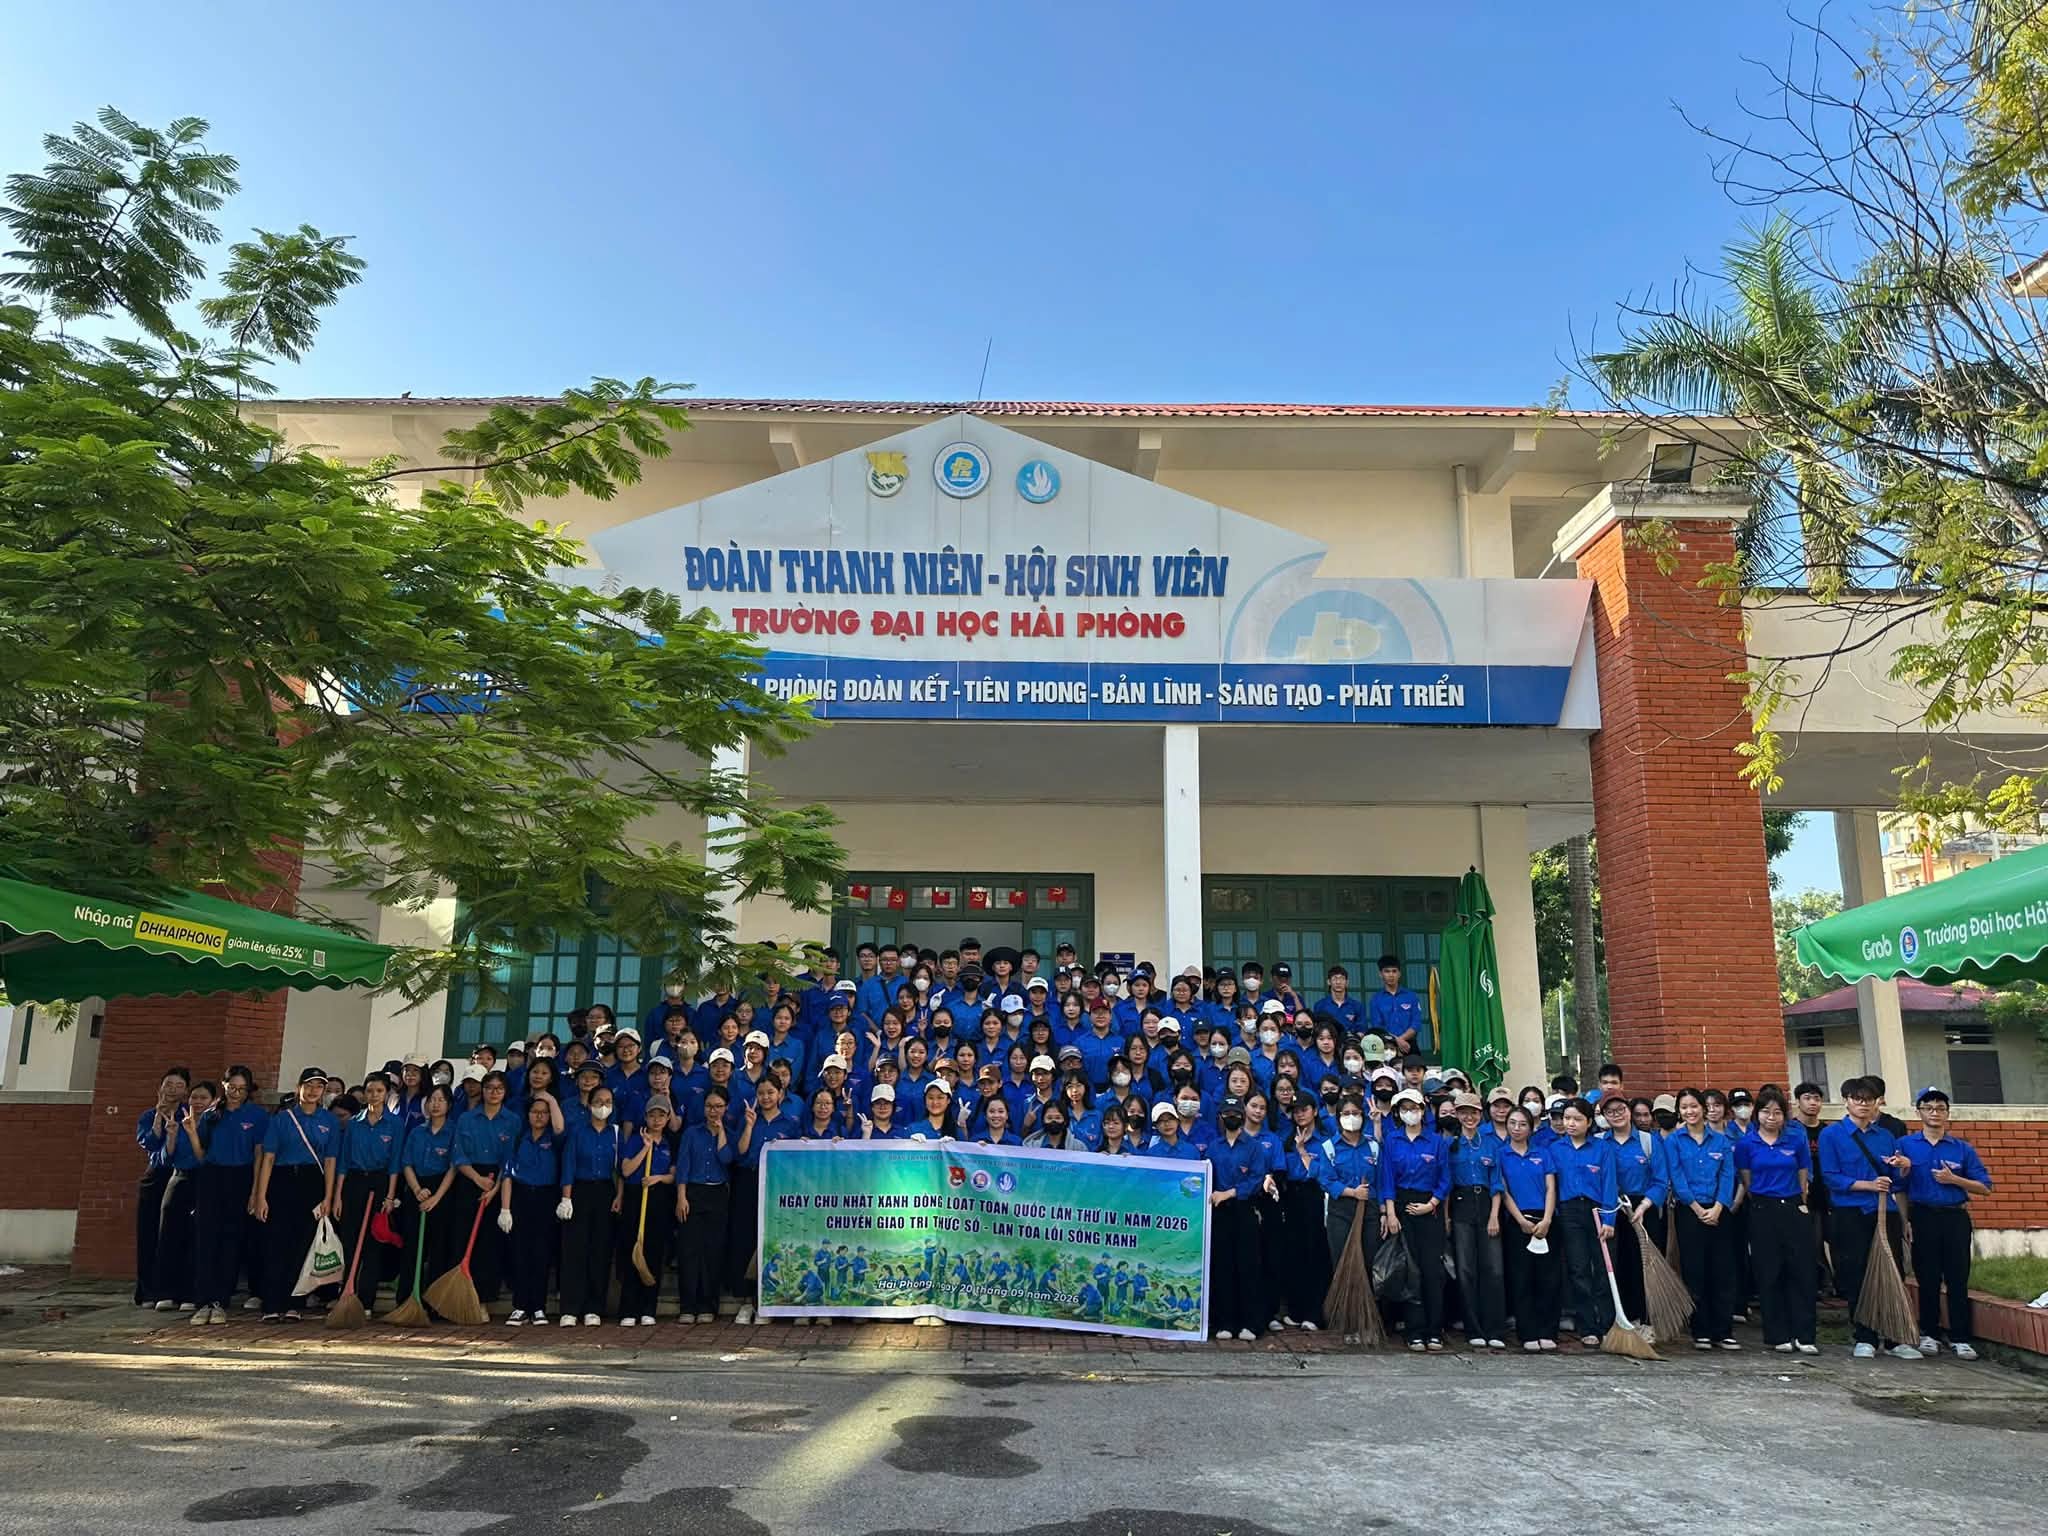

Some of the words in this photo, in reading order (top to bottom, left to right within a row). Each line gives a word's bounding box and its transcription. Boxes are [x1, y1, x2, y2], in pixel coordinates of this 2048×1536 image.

[685, 540, 771, 592] ĐOÀN
[779, 550, 894, 594] THANH
[903, 545, 983, 596] NIÊN
[1005, 545, 1056, 602] HỘI
[1066, 555, 1141, 597] SINH
[1153, 547, 1229, 597] VIÊN
[732, 602, 860, 635] TRƯỜNG
[871, 611, 924, 641] ĐẠI
[937, 611, 998, 642] HỌC
[1011, 605, 1064, 637] HẢI
[1077, 606, 1185, 638] PHÒNG
[844, 674, 903, 701] ĐOÀN
[910, 673, 949, 701] KẾT
[964, 676, 1009, 703] TIÊN
[1017, 681, 1087, 704] PHONG
[1102, 674, 1145, 704] BẢN
[1153, 677, 1201, 705] LĨNH
[1218, 679, 1277, 706] SÁNG
[1283, 684, 1322, 710] TẠO
[1339, 680, 1393, 706] PHÁT
[1400, 674, 1465, 707] TRIỂN
[74, 906, 110, 926] Nhập
[112, 915, 135, 929] mã
[139, 920, 222, 948] DHHAIPHONG
[1862, 934, 1892, 960] Grab
[1923, 923, 1967, 947] Trường
[1970, 914, 1992, 940] Đại
[1995, 912, 2022, 935] học
[877, 1195, 908, 1208] XANH
[1156, 1216, 1188, 1231] 2026
[877, 1216, 904, 1229] GIAO
[910, 1216, 928, 1228] TRI
[993, 1222, 1013, 1236] LAN
[1105, 1233, 1137, 1248] XANH
[960, 1284, 973, 1293] 20
[1011, 1288, 1024, 1297] 09
[1054, 1293, 1079, 1303] 2026
